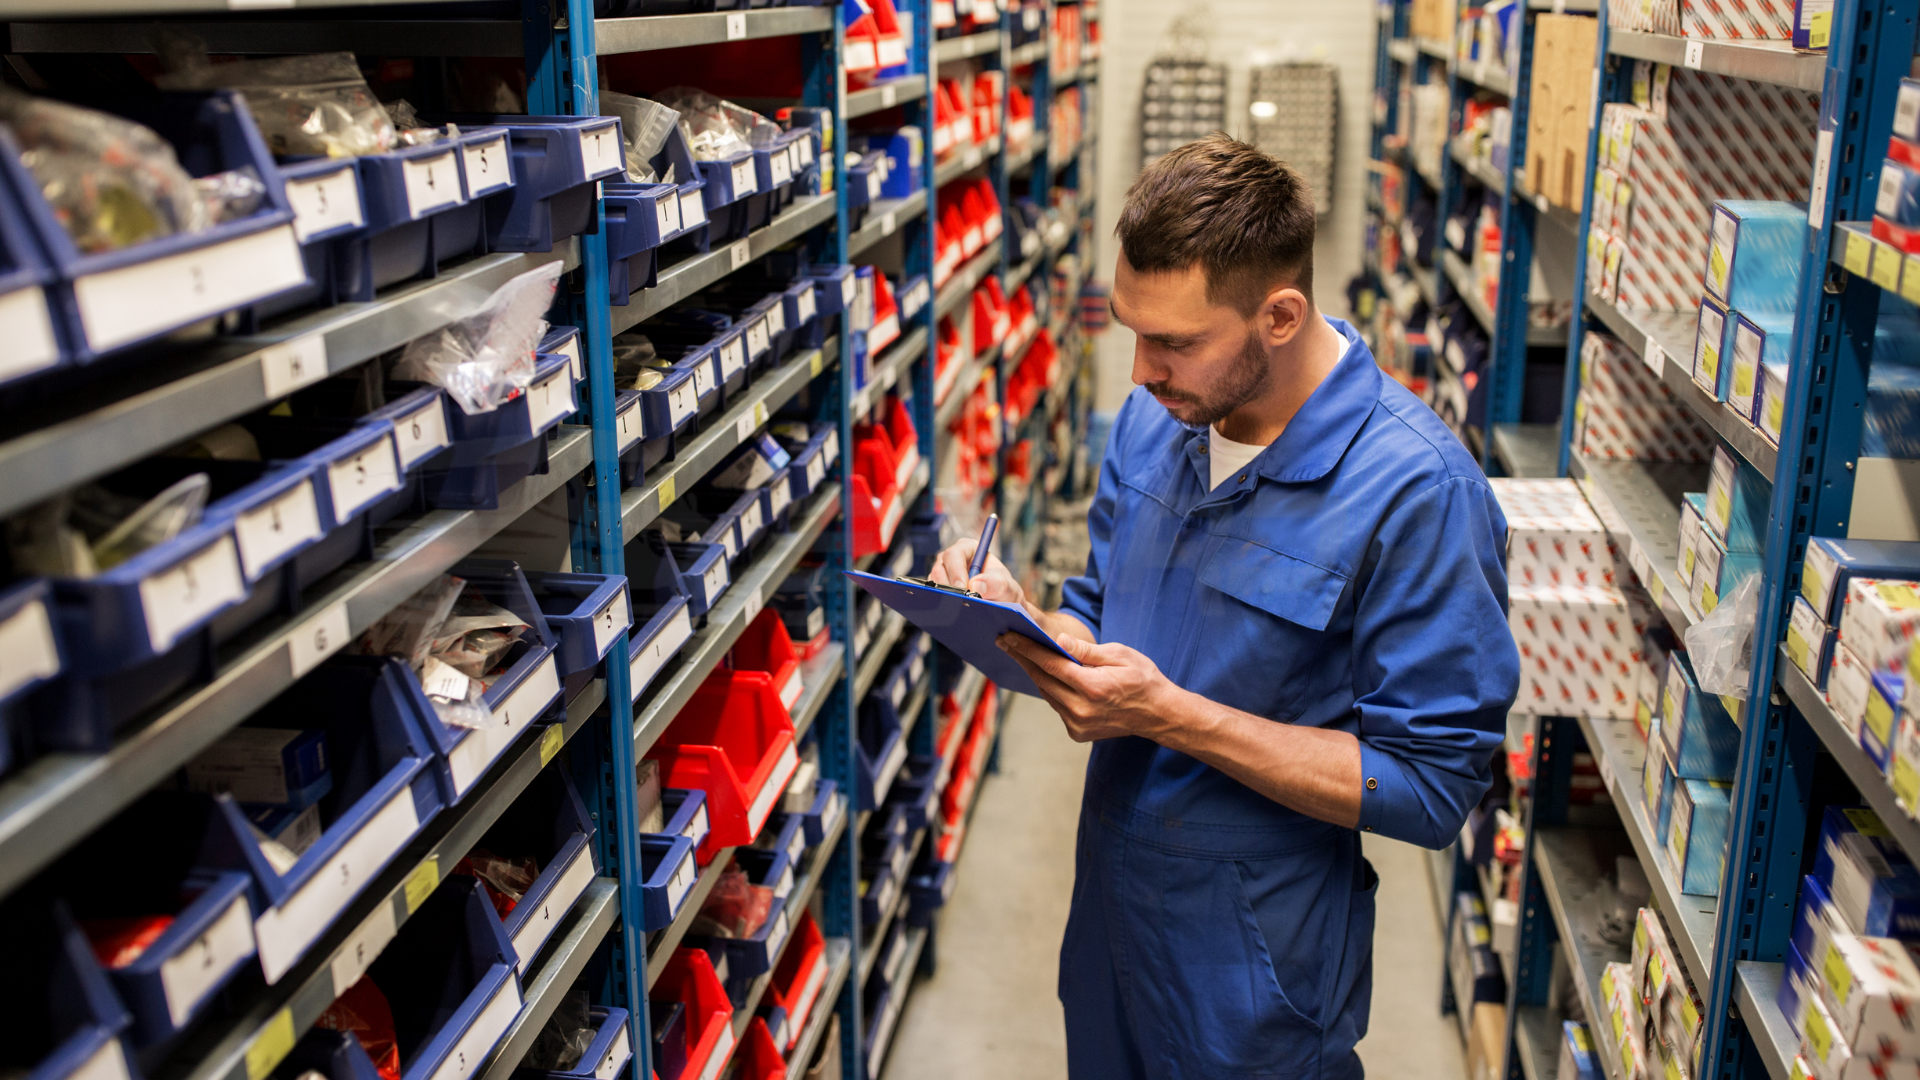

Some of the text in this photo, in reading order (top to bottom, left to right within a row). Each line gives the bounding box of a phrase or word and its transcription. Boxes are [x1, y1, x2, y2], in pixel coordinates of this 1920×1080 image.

[481, 148, 488, 173] 5
[663, 202, 668, 221] 1
[411, 415, 421, 440] 6
[622, 415, 627, 434] 1
[606, 607, 612, 629] 5
[504, 710, 510, 726] 4
[544, 905, 549, 920] 4
